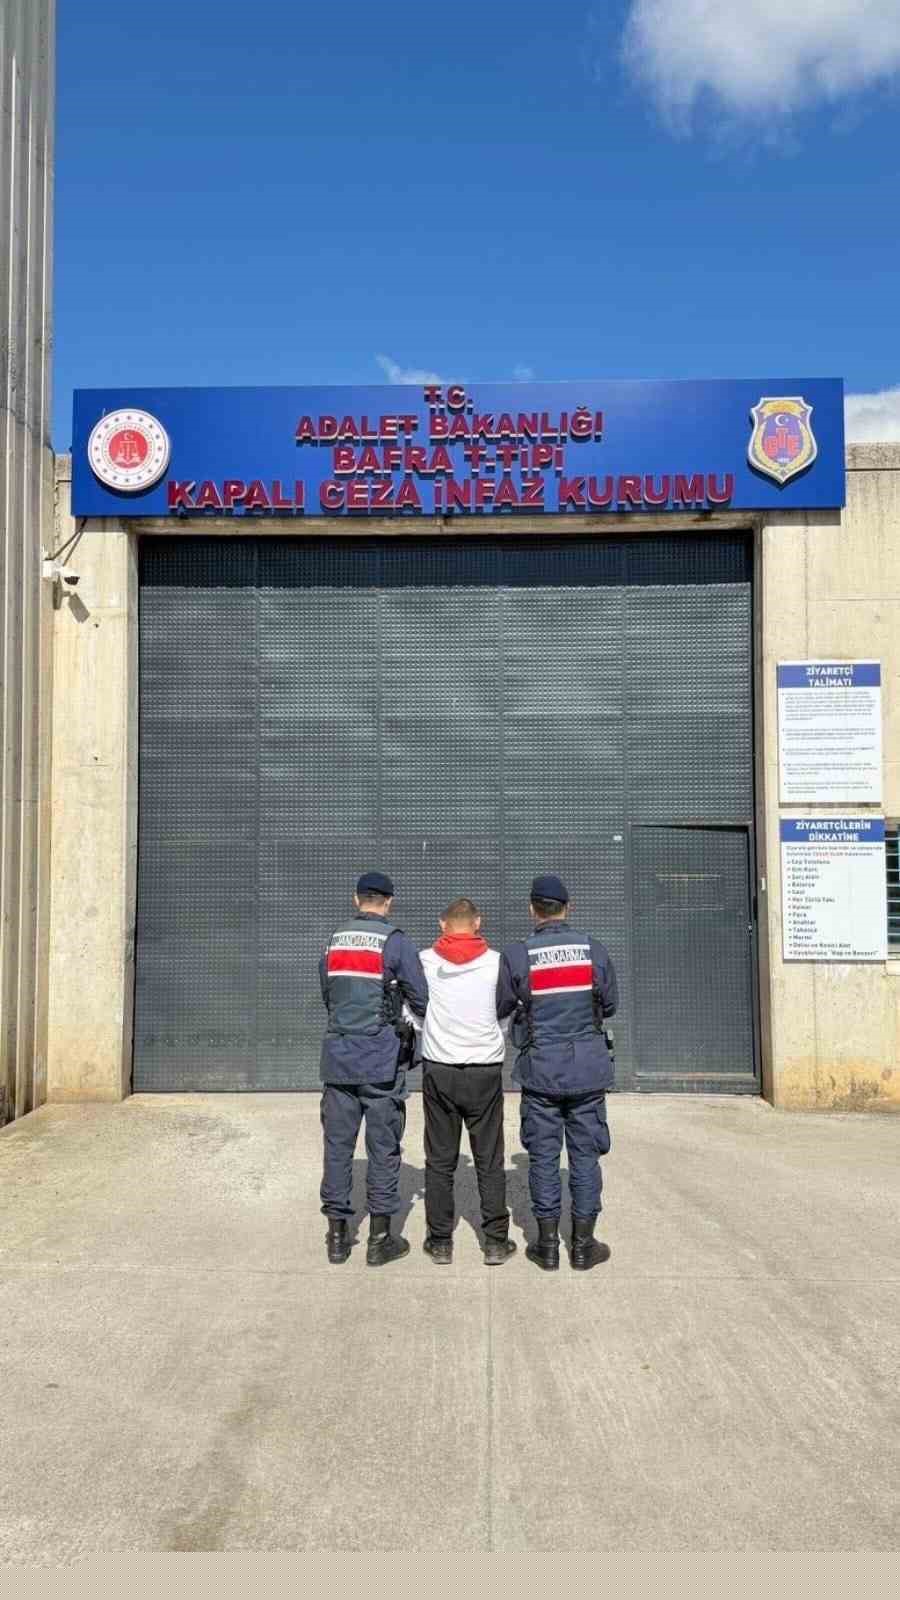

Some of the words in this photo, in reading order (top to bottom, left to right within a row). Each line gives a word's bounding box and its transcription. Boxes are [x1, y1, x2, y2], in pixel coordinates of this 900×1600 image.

[295, 415, 418, 441] ADALET
[429, 406, 604, 439] BAKANLIĞI
[333, 446, 454, 474] BAFRA
[167, 479, 304, 509] KAPALI
[319, 479, 421, 508] CEZA
[558, 473, 735, 506] KURUMU
[805, 664, 854, 676] ZİYARETÇİ
[808, 677, 853, 687] TALİMATI
[795, 819, 872, 831] ZİYARETÇİLERİN
[808, 832, 860, 842] DİKKATİNE
[334, 933, 379, 948] JANDARMA
[535, 948, 587, 965] JANDARMA
